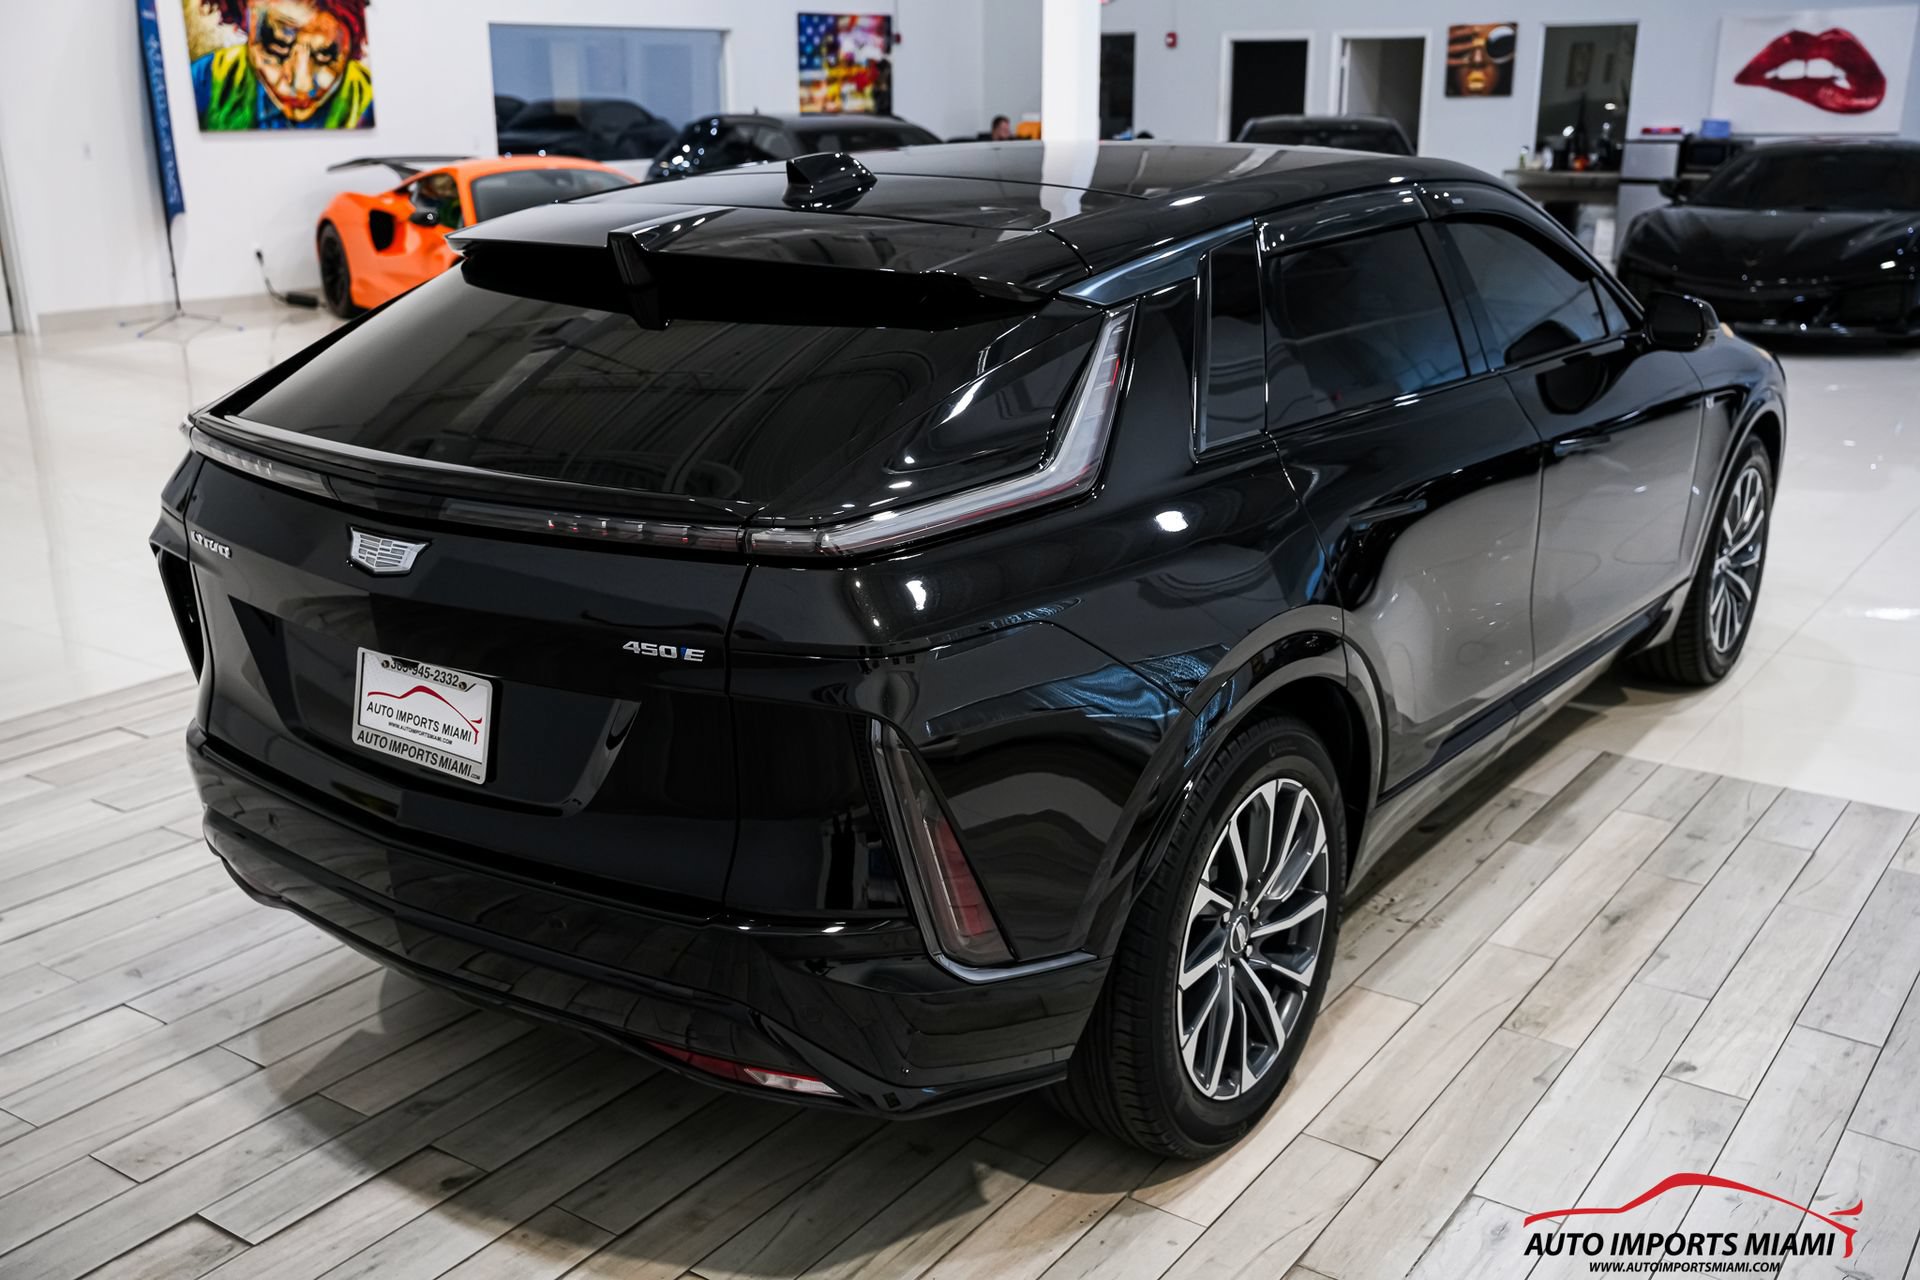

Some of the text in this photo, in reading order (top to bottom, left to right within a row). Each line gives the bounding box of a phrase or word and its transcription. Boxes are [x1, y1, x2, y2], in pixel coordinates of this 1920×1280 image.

[366, 701, 472, 742] AUTO IMPORTS MIAMI
[357, 730, 388, 749] AUTO
[389, 739, 438, 766] IMPORTS
